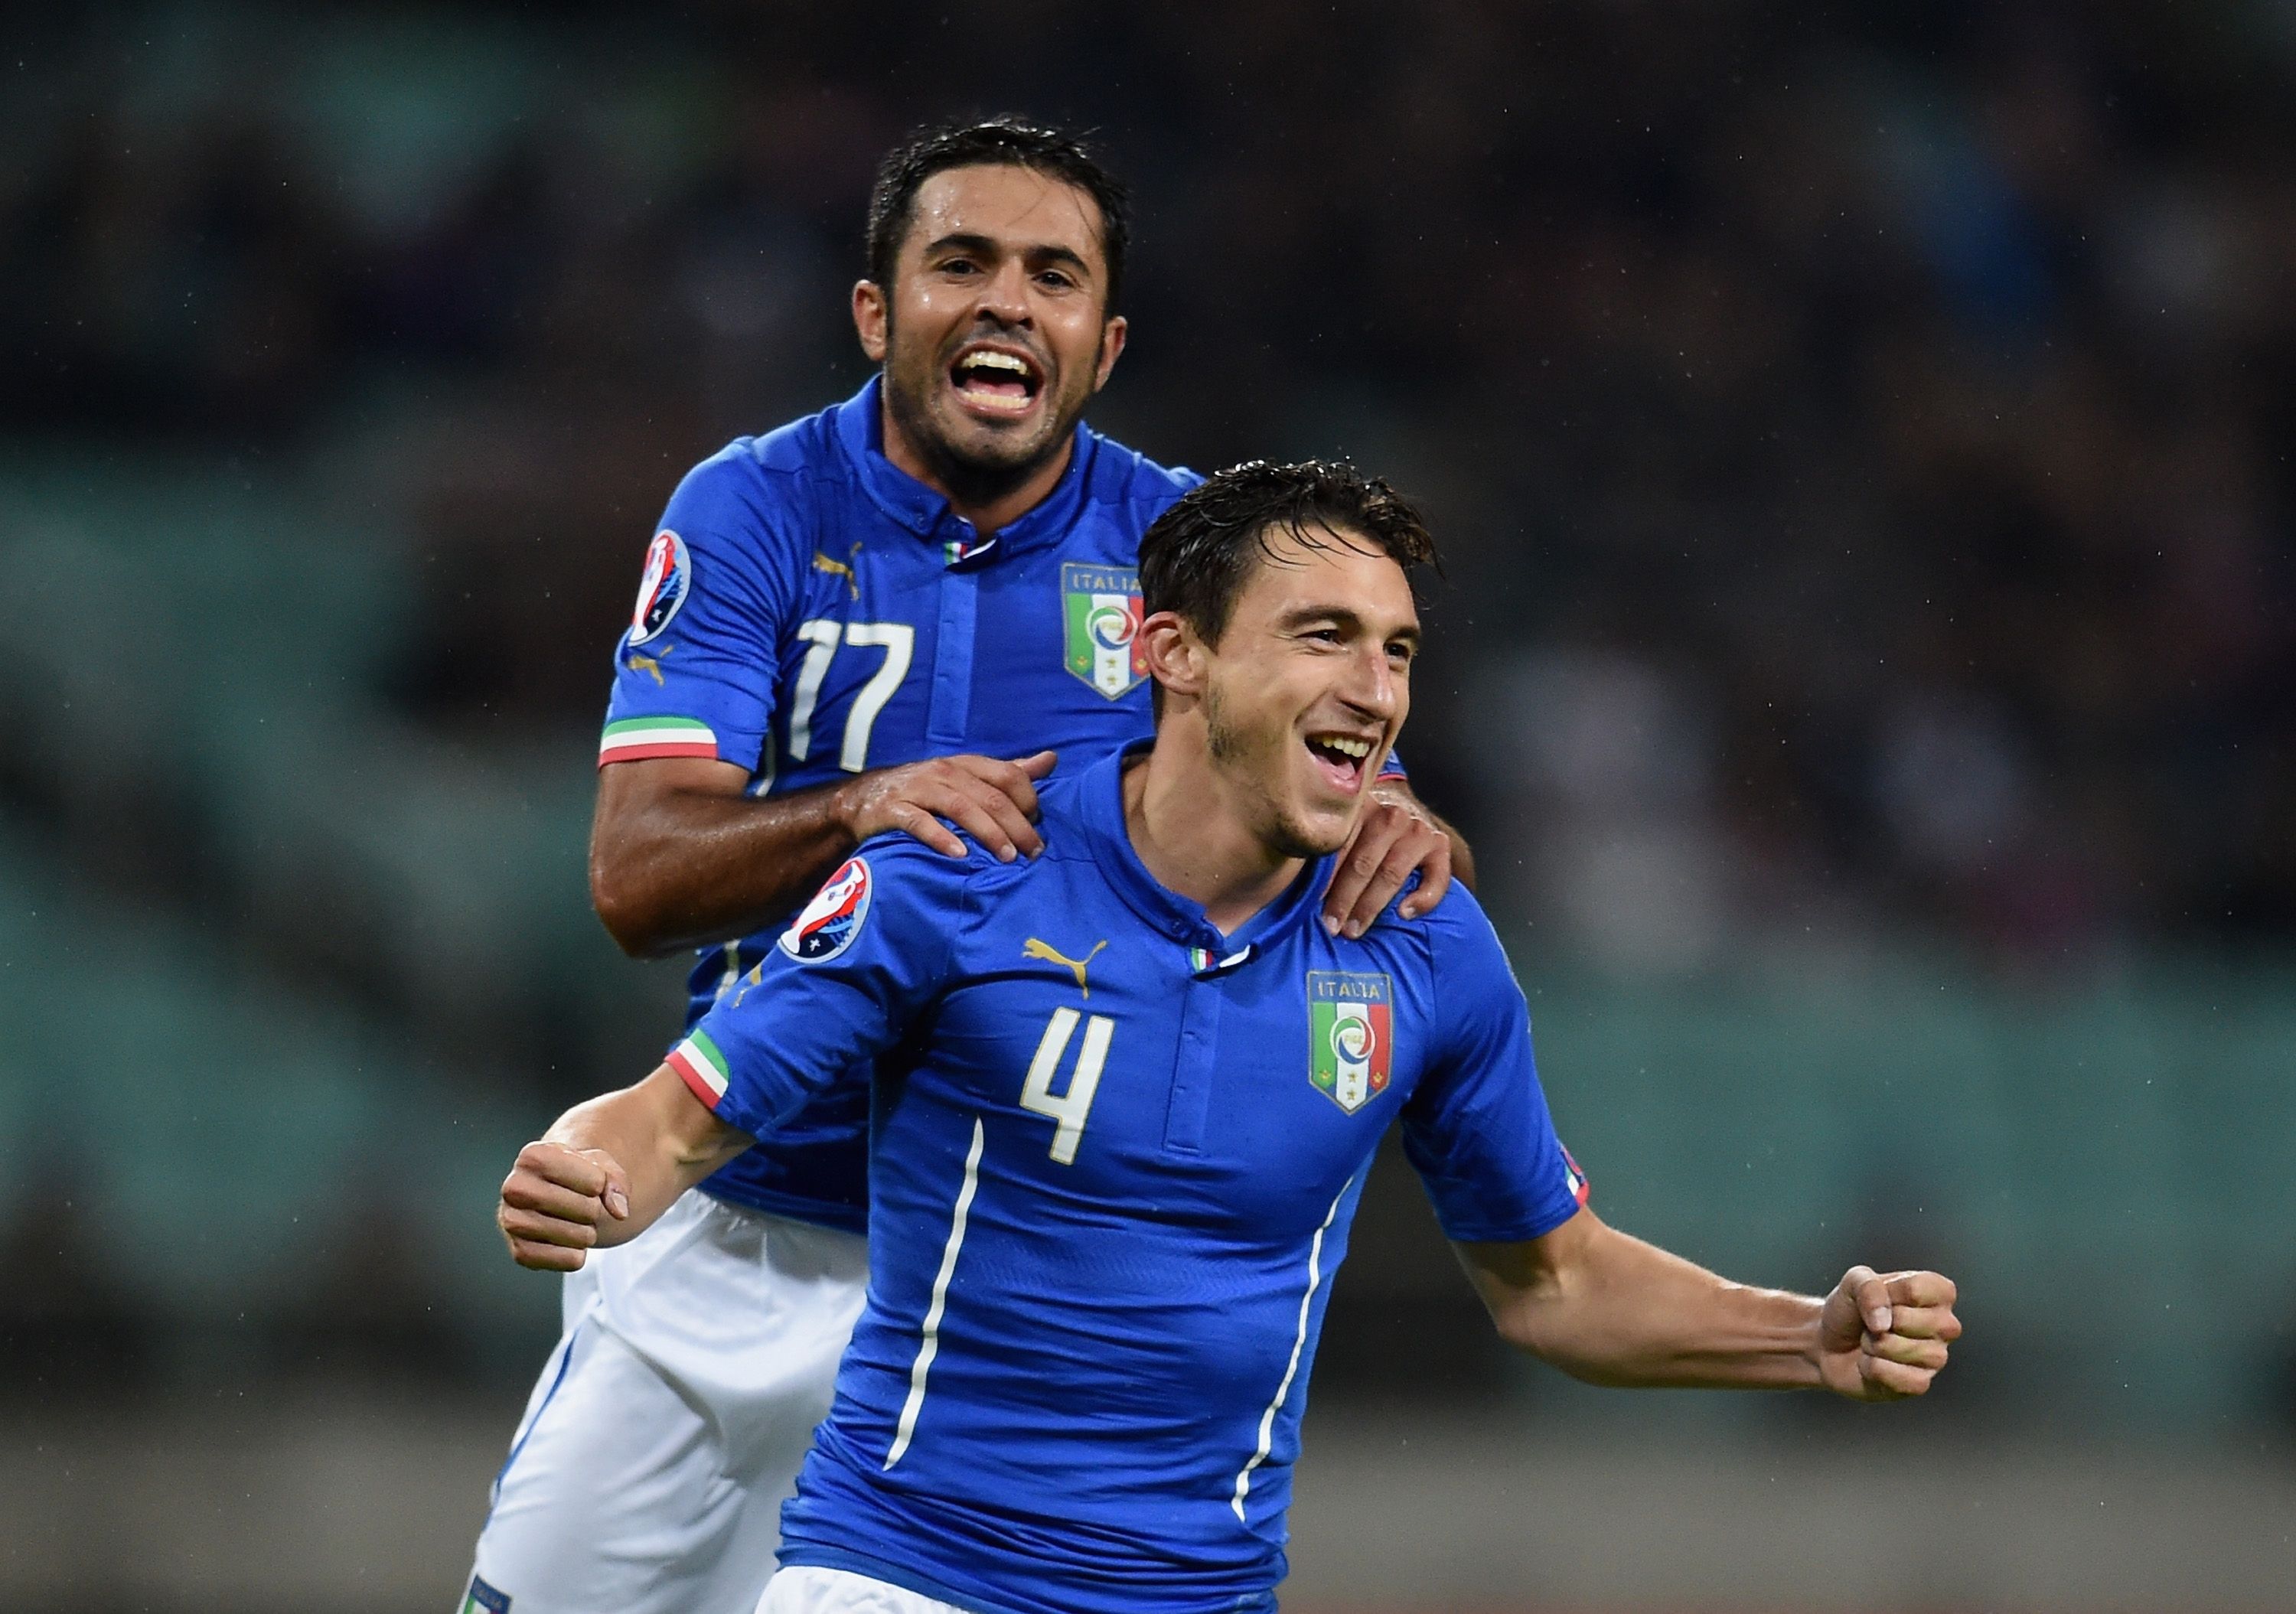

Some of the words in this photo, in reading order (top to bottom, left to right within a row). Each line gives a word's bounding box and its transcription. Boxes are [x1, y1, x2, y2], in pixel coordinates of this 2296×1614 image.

[1073, 574, 1142, 592] ITALIA
[789, 619, 915, 773] 17
[1318, 981, 1380, 999] ITALIA
[1019, 1006, 1115, 1166] 4
